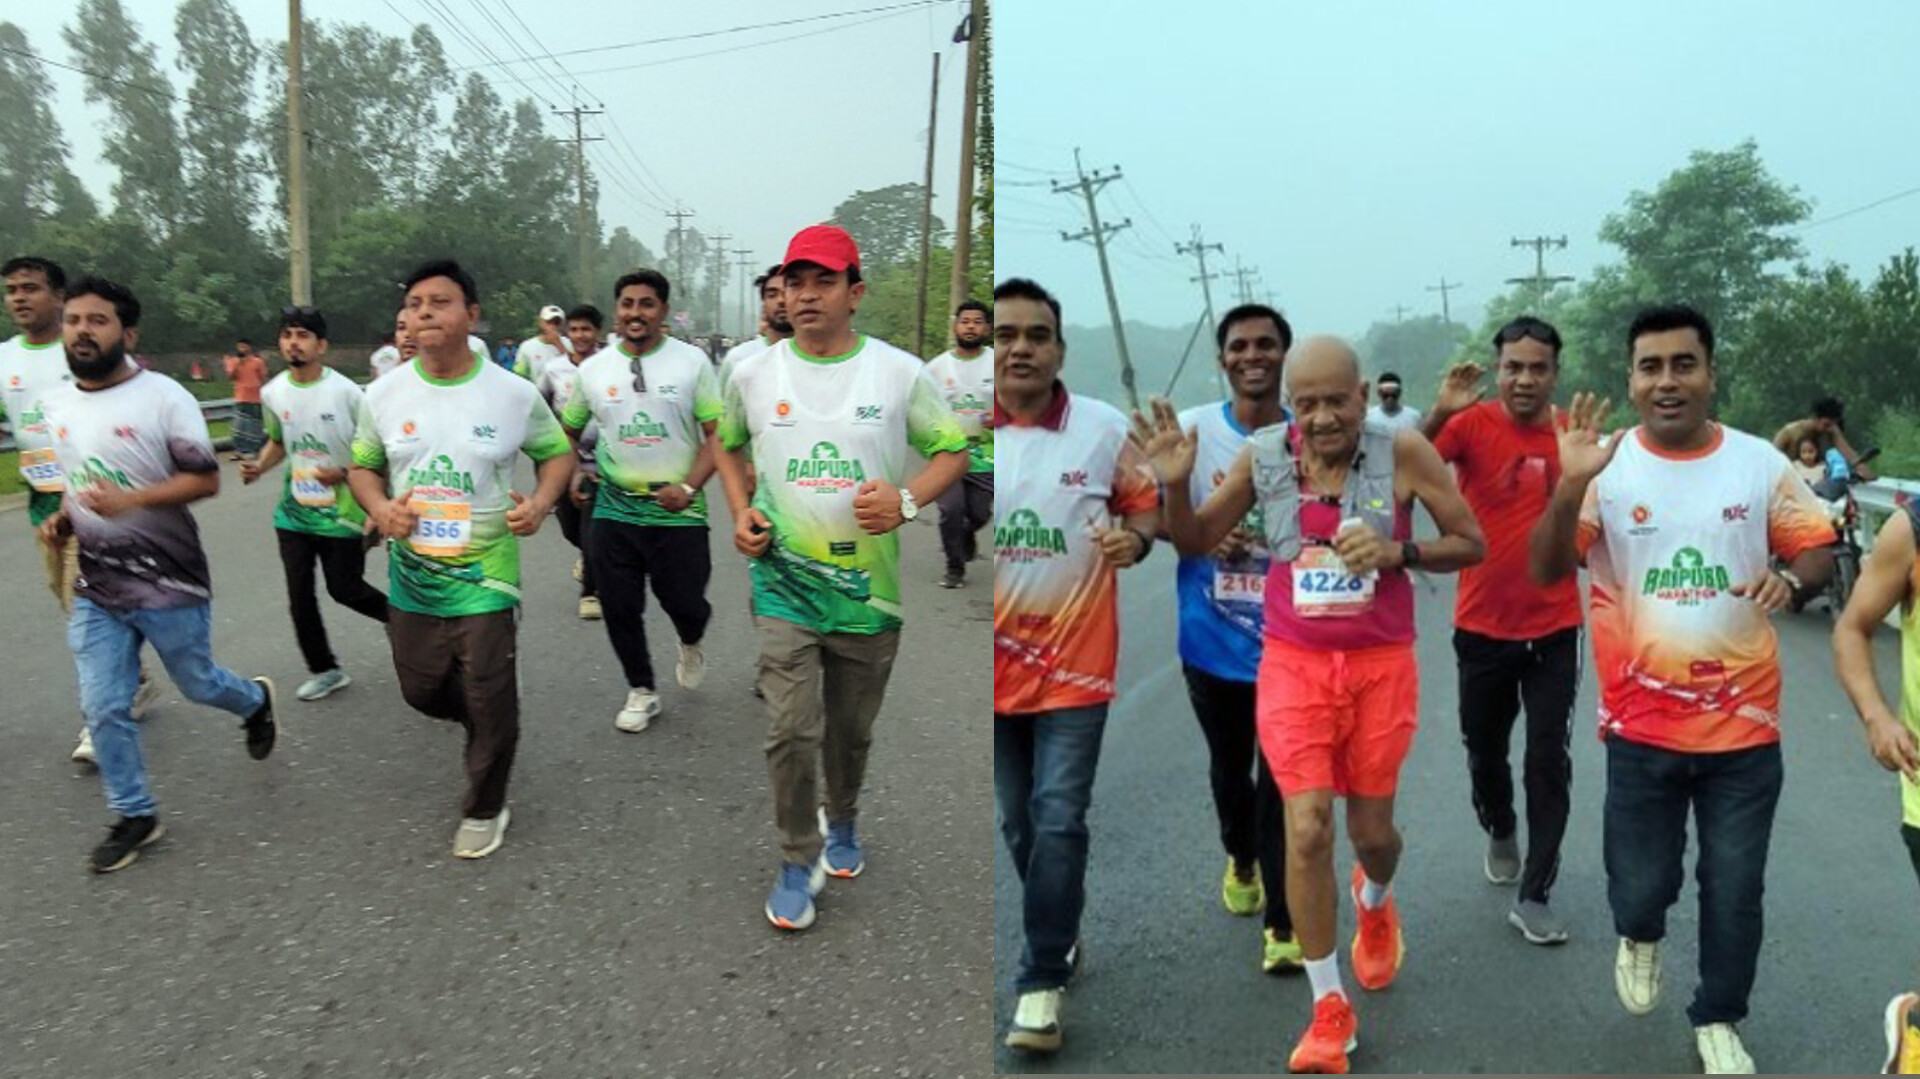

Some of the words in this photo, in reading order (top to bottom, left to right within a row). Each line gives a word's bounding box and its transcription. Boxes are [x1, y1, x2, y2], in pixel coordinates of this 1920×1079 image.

[785, 458, 867, 482] RAIPURA
[994, 526, 1068, 555] AIPURA
[1643, 565, 1730, 594] RAIPURA
